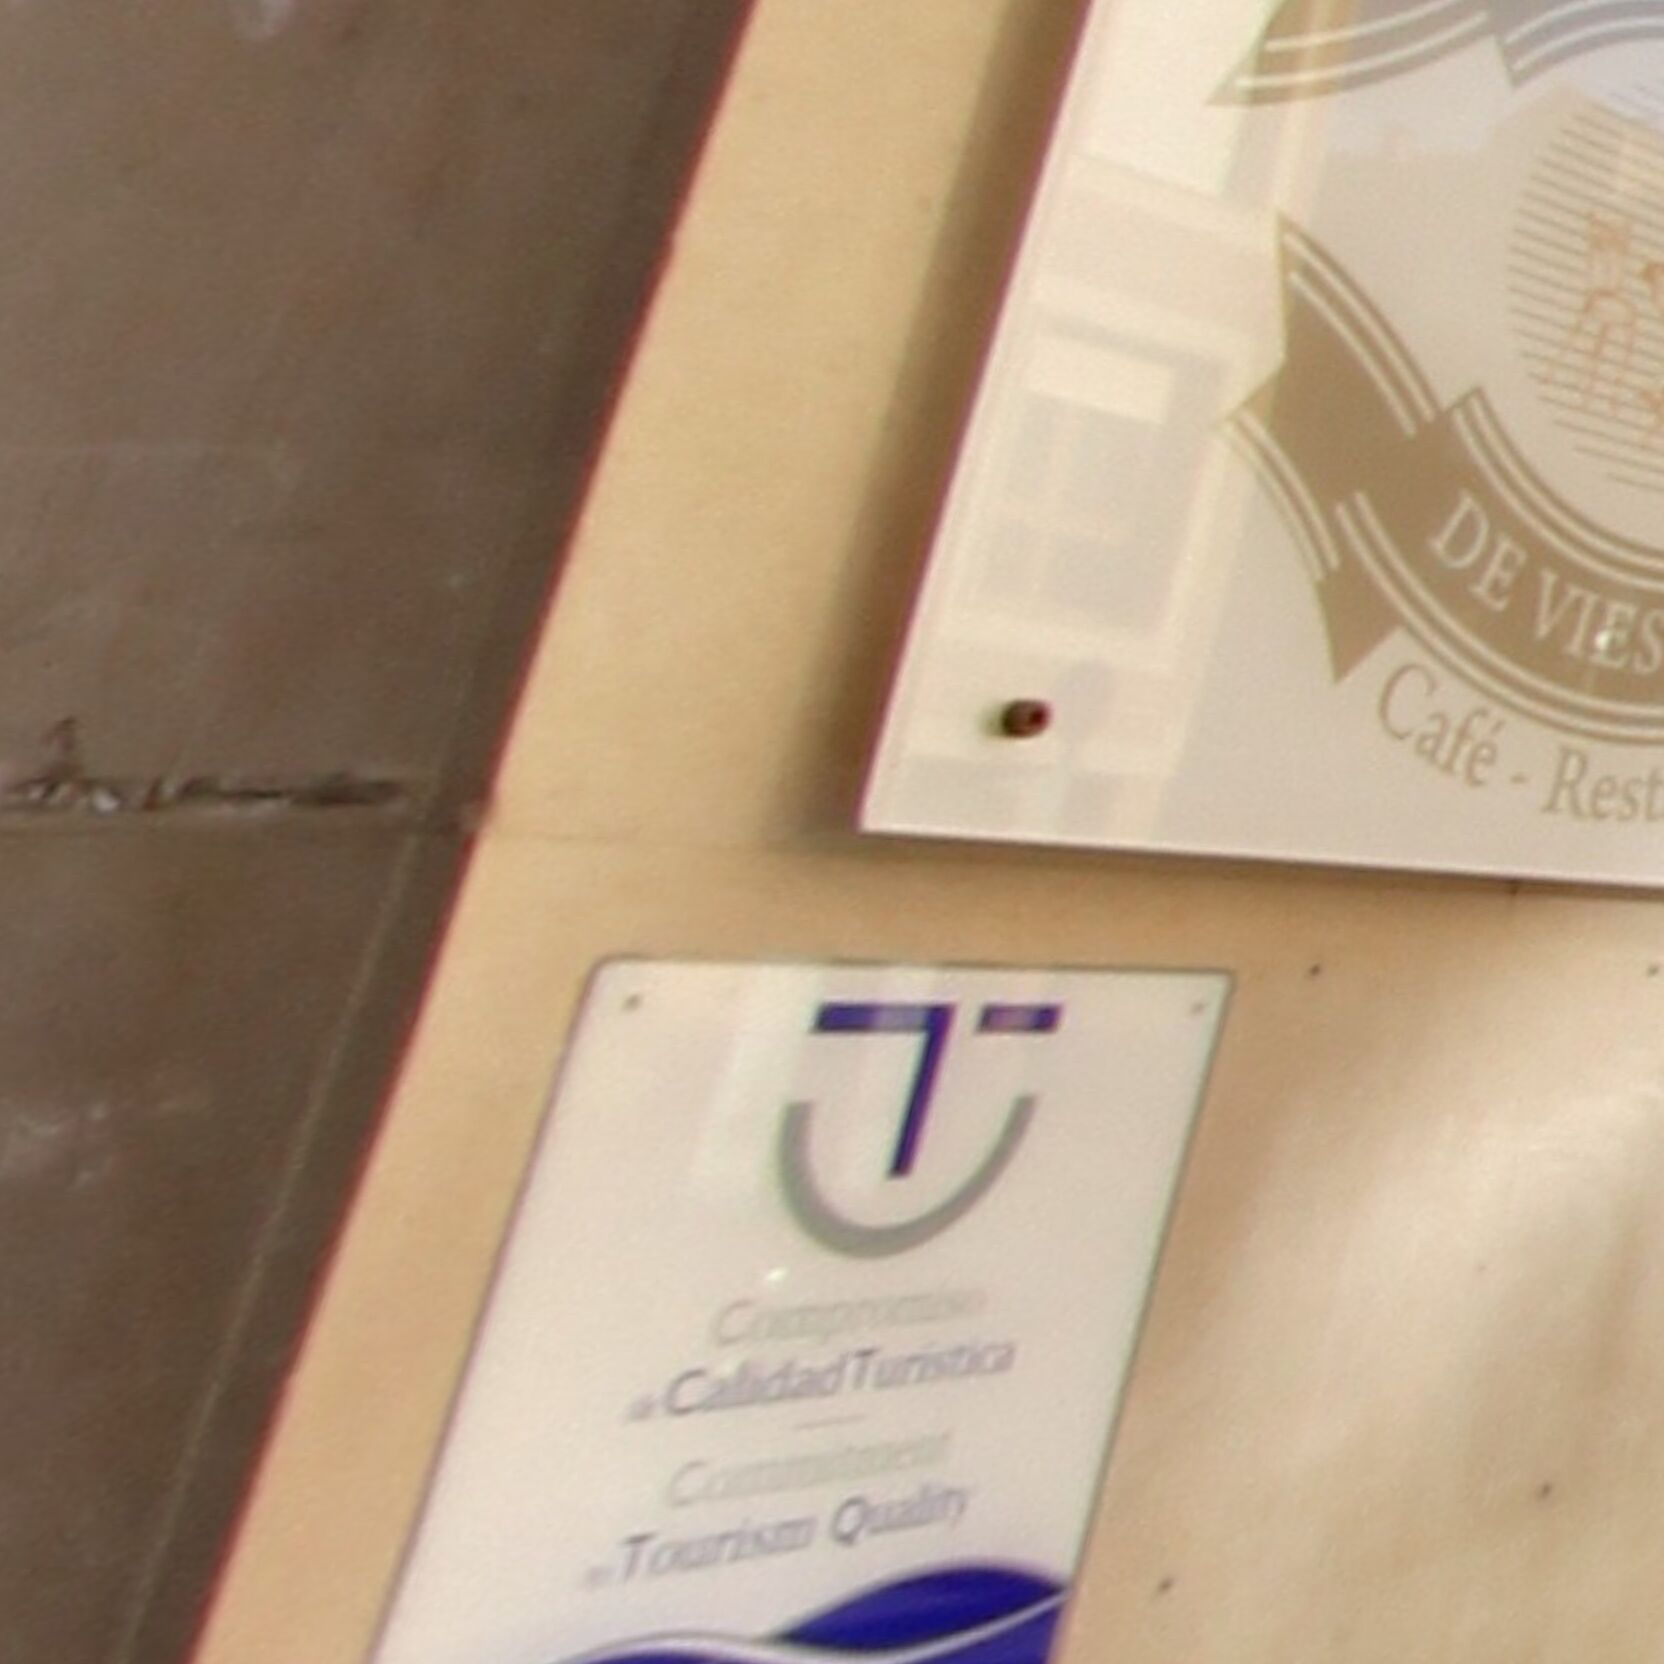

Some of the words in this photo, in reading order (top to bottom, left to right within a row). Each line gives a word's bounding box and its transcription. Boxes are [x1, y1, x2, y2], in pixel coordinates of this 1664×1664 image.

[1429, 487, 1528, 612] DE
[1378, 662, 1507, 787] Café
[618, 1516, 821, 1582] Tourism
[828, 1482, 970, 1548] Quality
